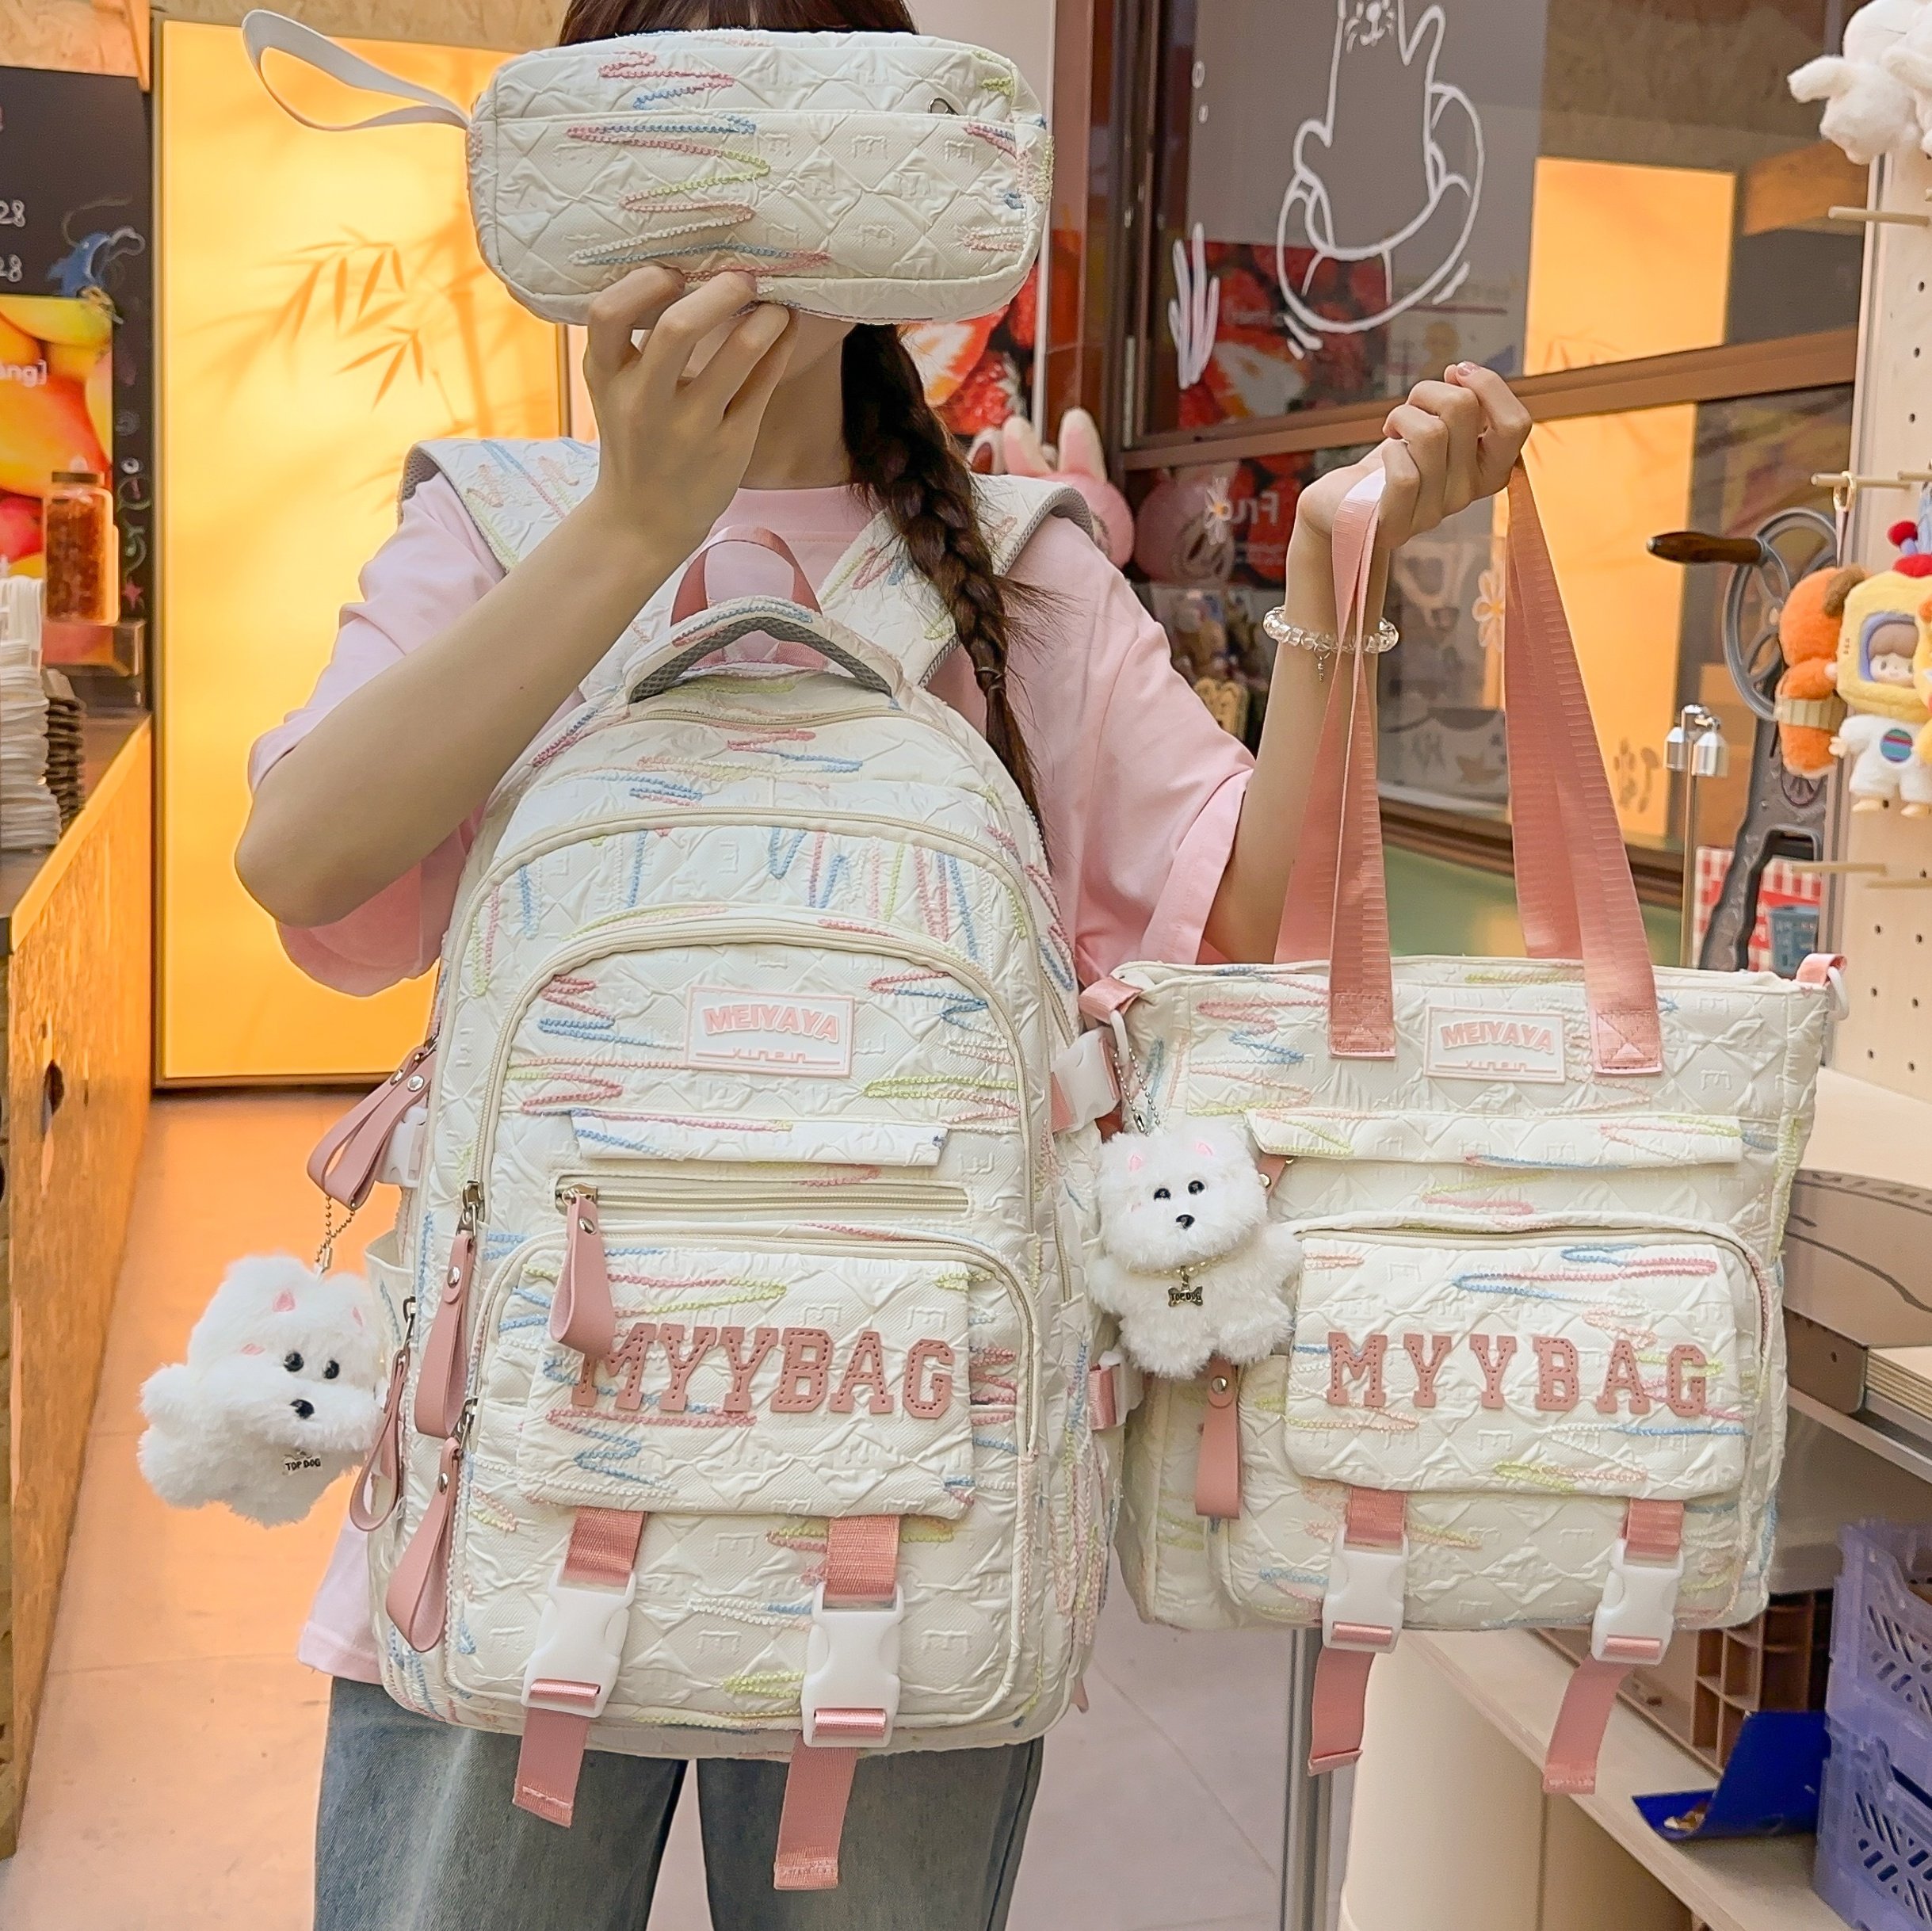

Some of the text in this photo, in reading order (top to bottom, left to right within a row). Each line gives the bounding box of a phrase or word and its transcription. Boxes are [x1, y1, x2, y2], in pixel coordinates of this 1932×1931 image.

[703, 1003, 840, 1044] MEIYAYA
[1440, 1019, 1555, 1055] MEIYAYA
[571, 1322, 956, 1419] MYYBAG
[1327, 1330, 1708, 1418] MYYBAG
[285, 1458, 321, 1471] TOP DOG
